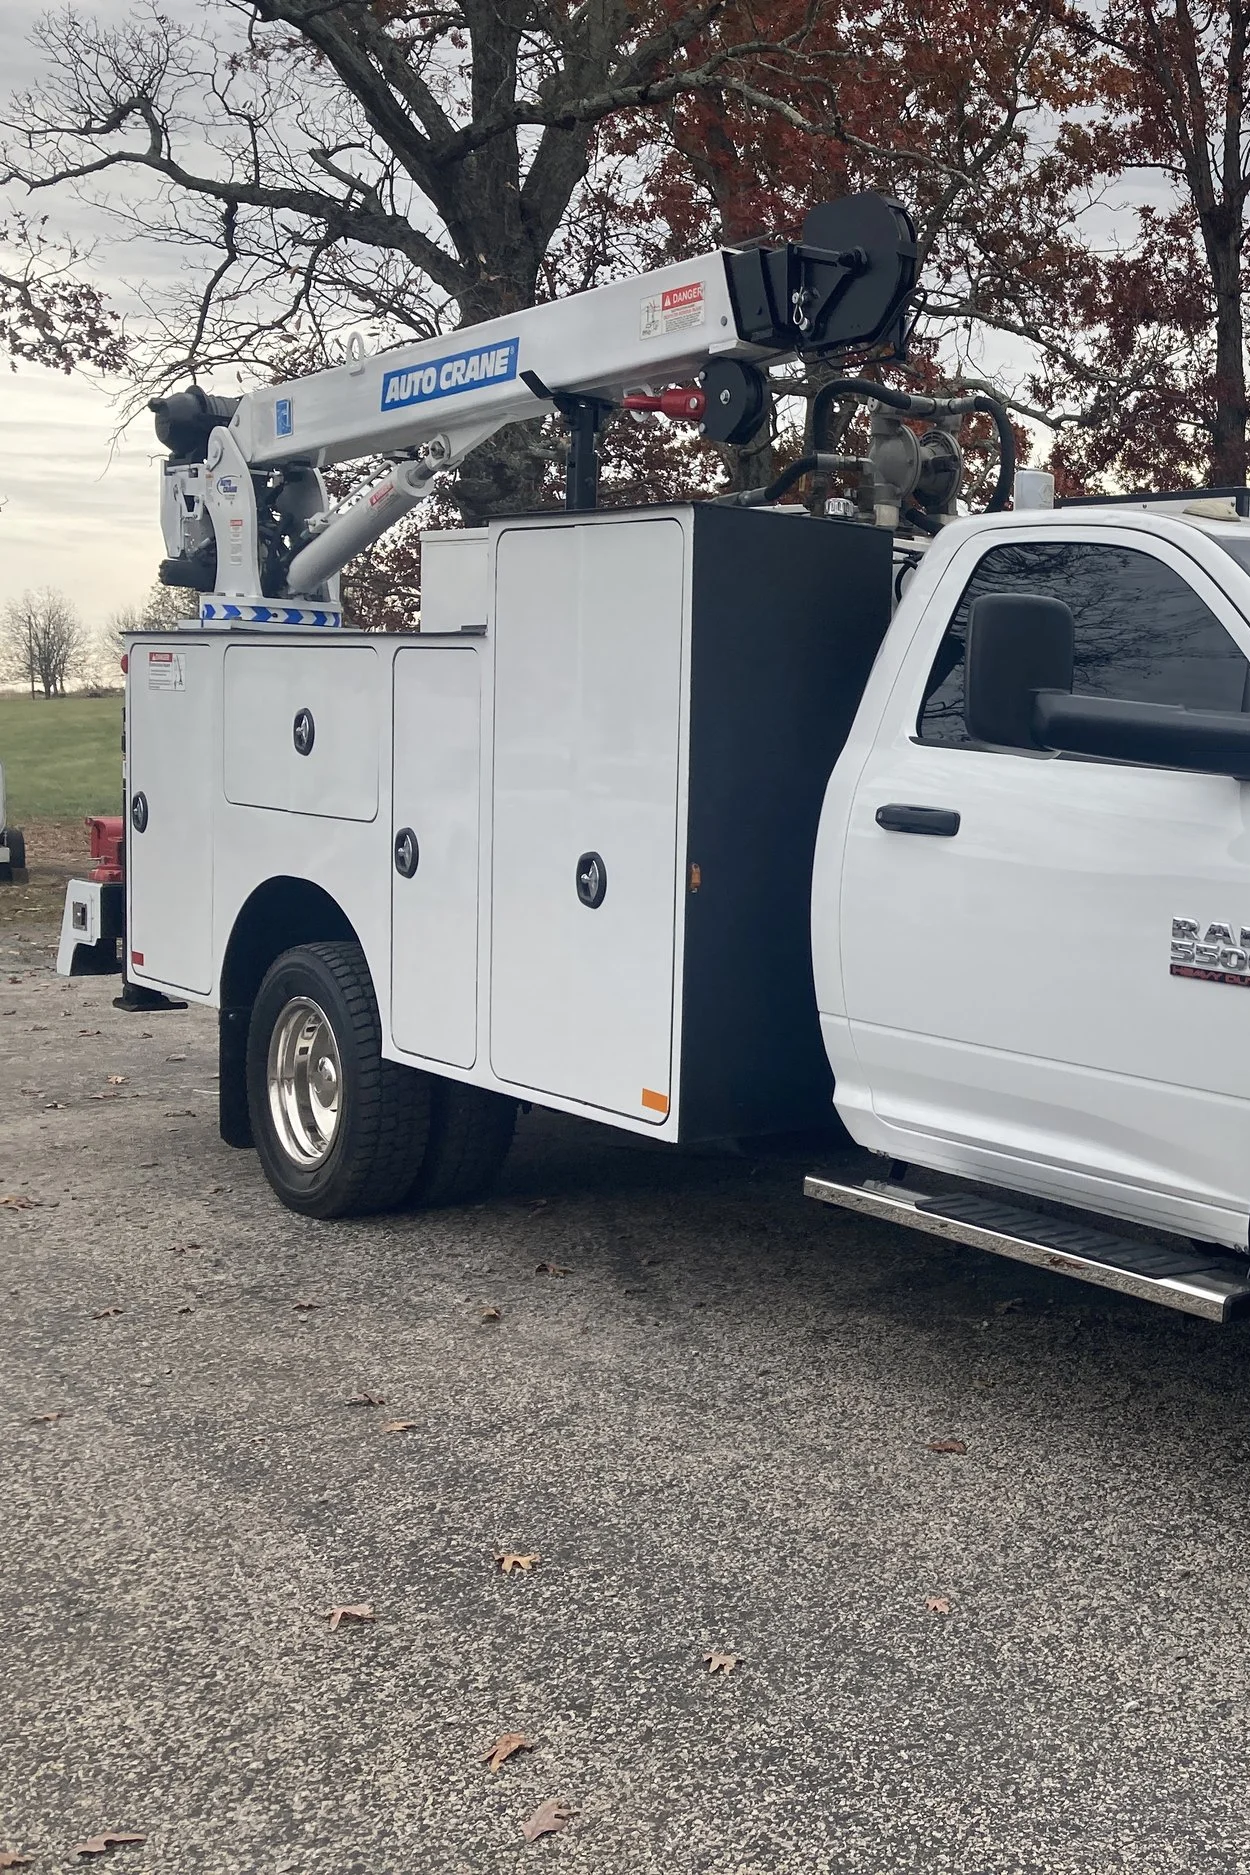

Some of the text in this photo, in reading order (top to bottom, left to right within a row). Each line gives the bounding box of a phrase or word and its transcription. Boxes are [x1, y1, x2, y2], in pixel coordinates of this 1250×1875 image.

[672, 287, 704, 304] DANGER
[385, 346, 510, 404] AUTO CRANE
[1172, 965, 1221, 982] HEAVY
